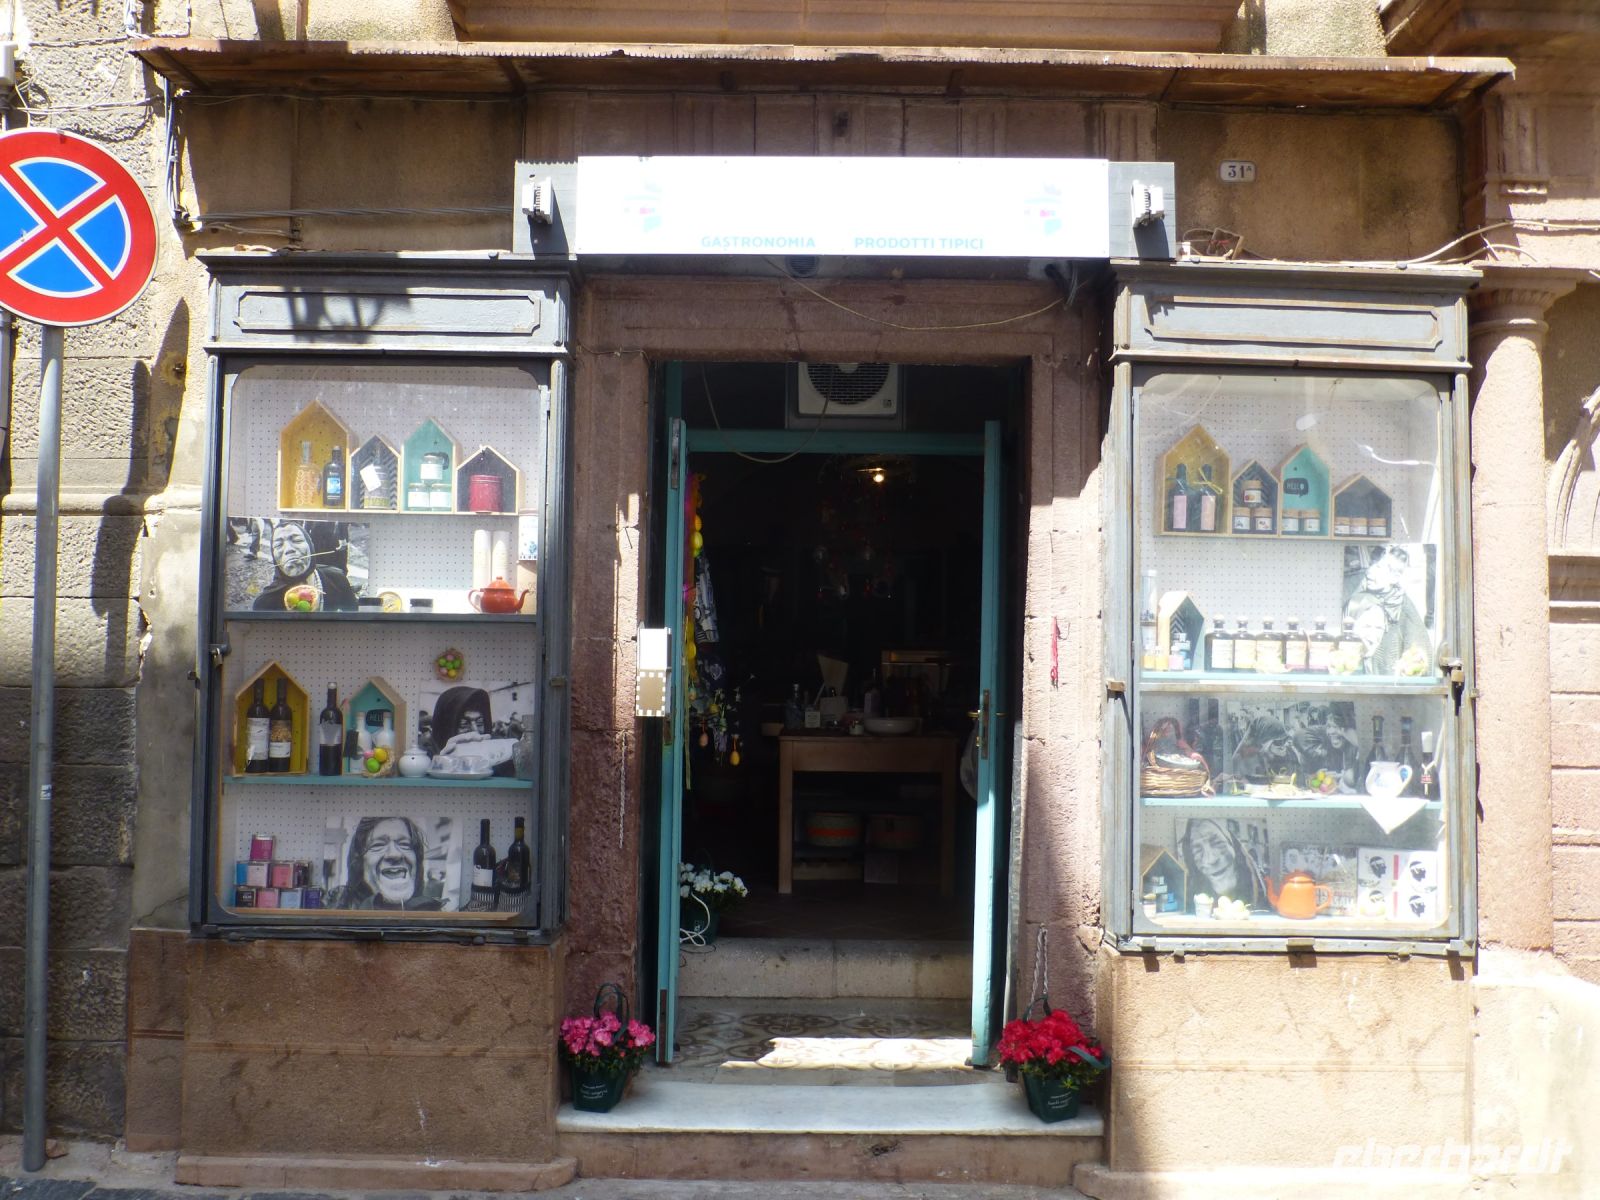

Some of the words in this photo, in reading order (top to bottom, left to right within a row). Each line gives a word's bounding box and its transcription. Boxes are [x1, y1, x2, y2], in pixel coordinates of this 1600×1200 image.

[701, 236, 816, 249] GASTRONOMIA
[854, 237, 935, 249] PRODOTTI
[938, 238, 984, 250] TIPICI
